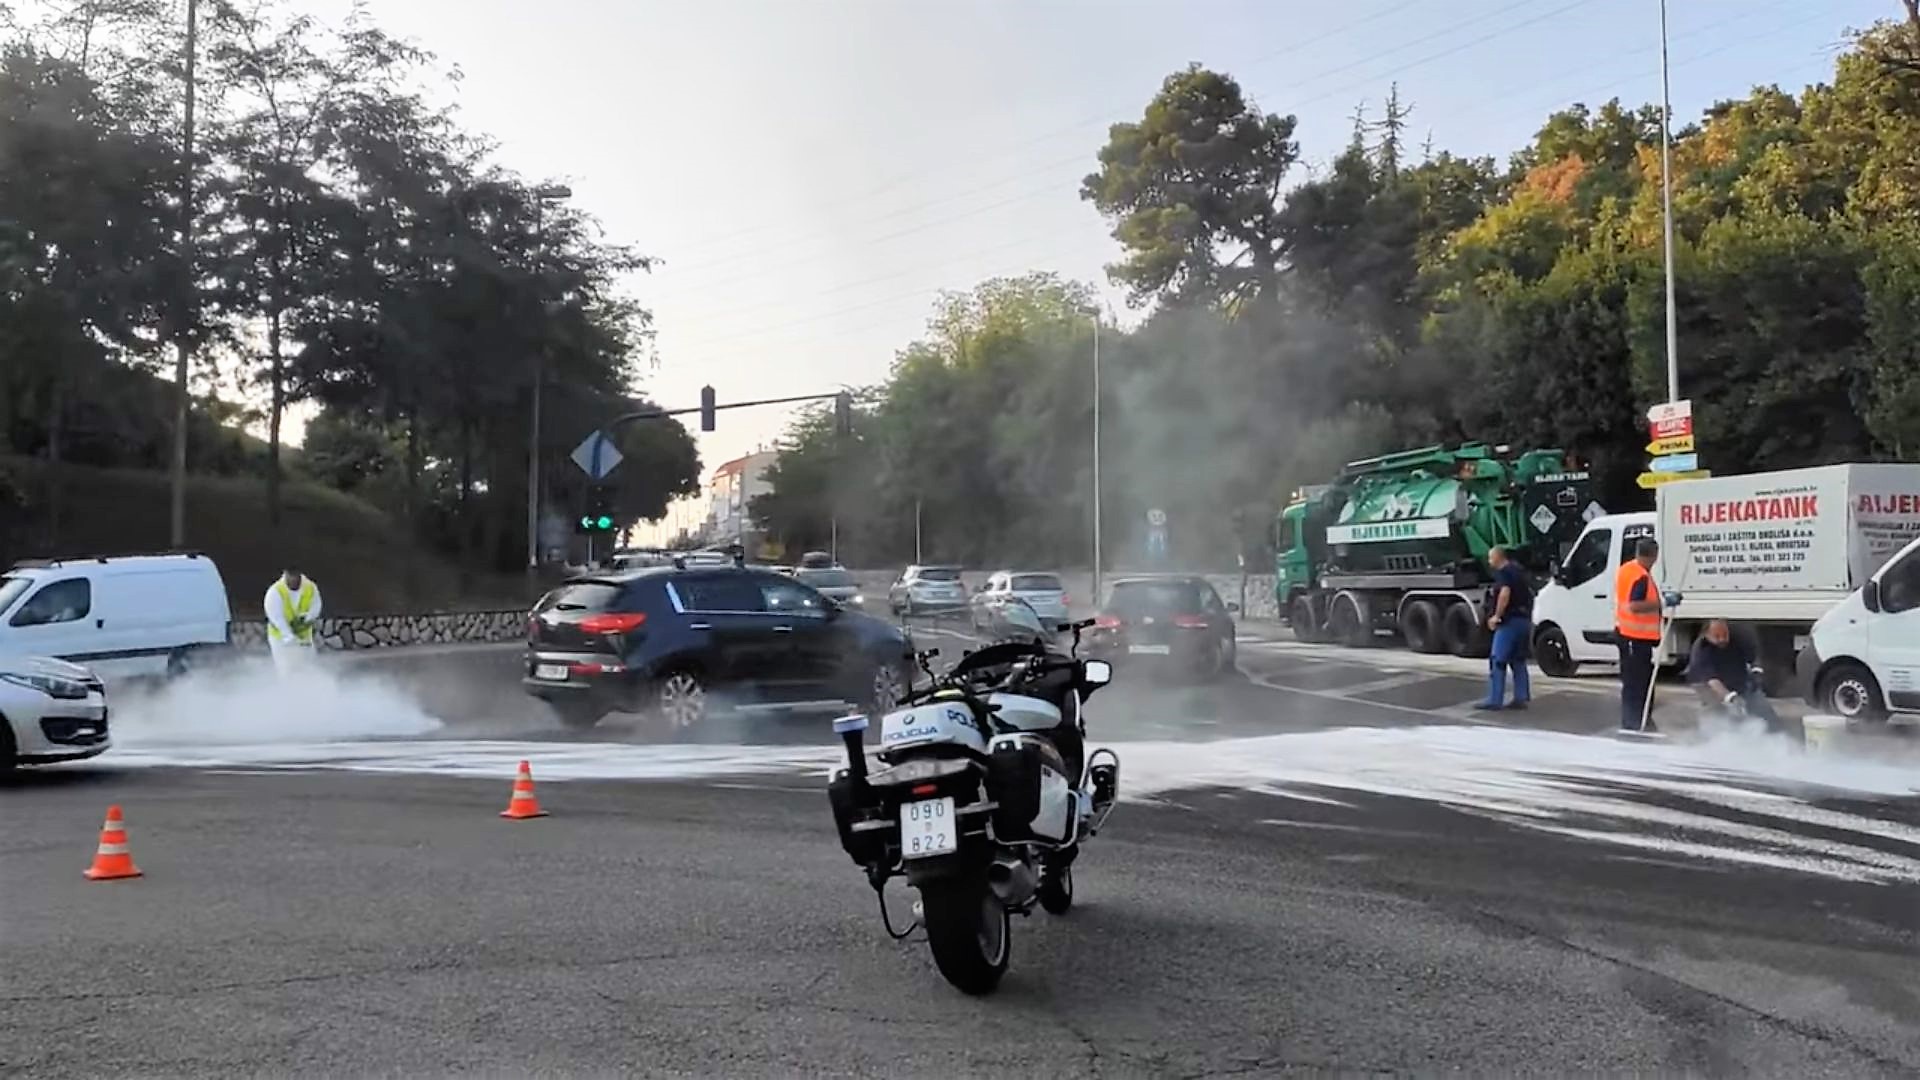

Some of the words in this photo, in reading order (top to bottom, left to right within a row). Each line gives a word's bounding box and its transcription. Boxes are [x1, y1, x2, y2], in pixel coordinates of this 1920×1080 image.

[1680, 495, 1819, 525] RIJEKATANK
[1351, 523, 1417, 539] RIJEKATANK
[884, 727, 939, 741] POLICIJA
[910, 802, 945, 822] 090
[911, 833, 947, 853] 822
